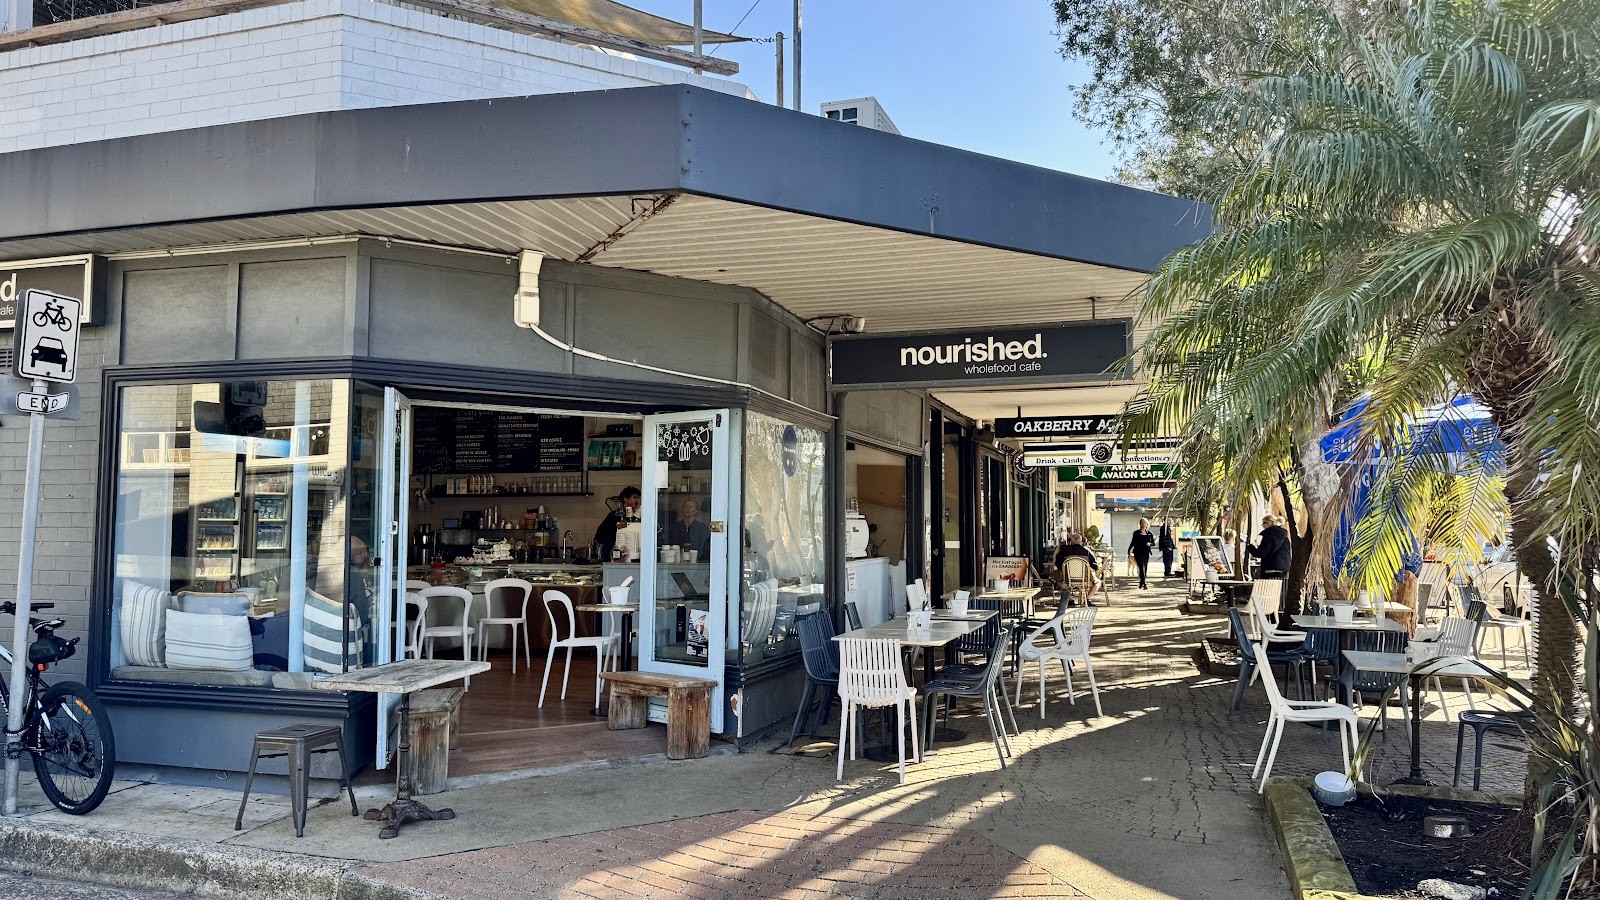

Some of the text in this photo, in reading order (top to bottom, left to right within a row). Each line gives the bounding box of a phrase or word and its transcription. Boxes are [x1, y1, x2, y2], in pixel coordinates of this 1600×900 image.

[900, 333, 1048, 366] nourished.
[964, 360, 1042, 375] wholefood cafe
[30, 397, 59, 409] END
[1014, 419, 1094, 433] OAKBERRY
[1062, 457, 1084, 465] Candy
[1101, 470, 1164, 479] AVALON CAFE
